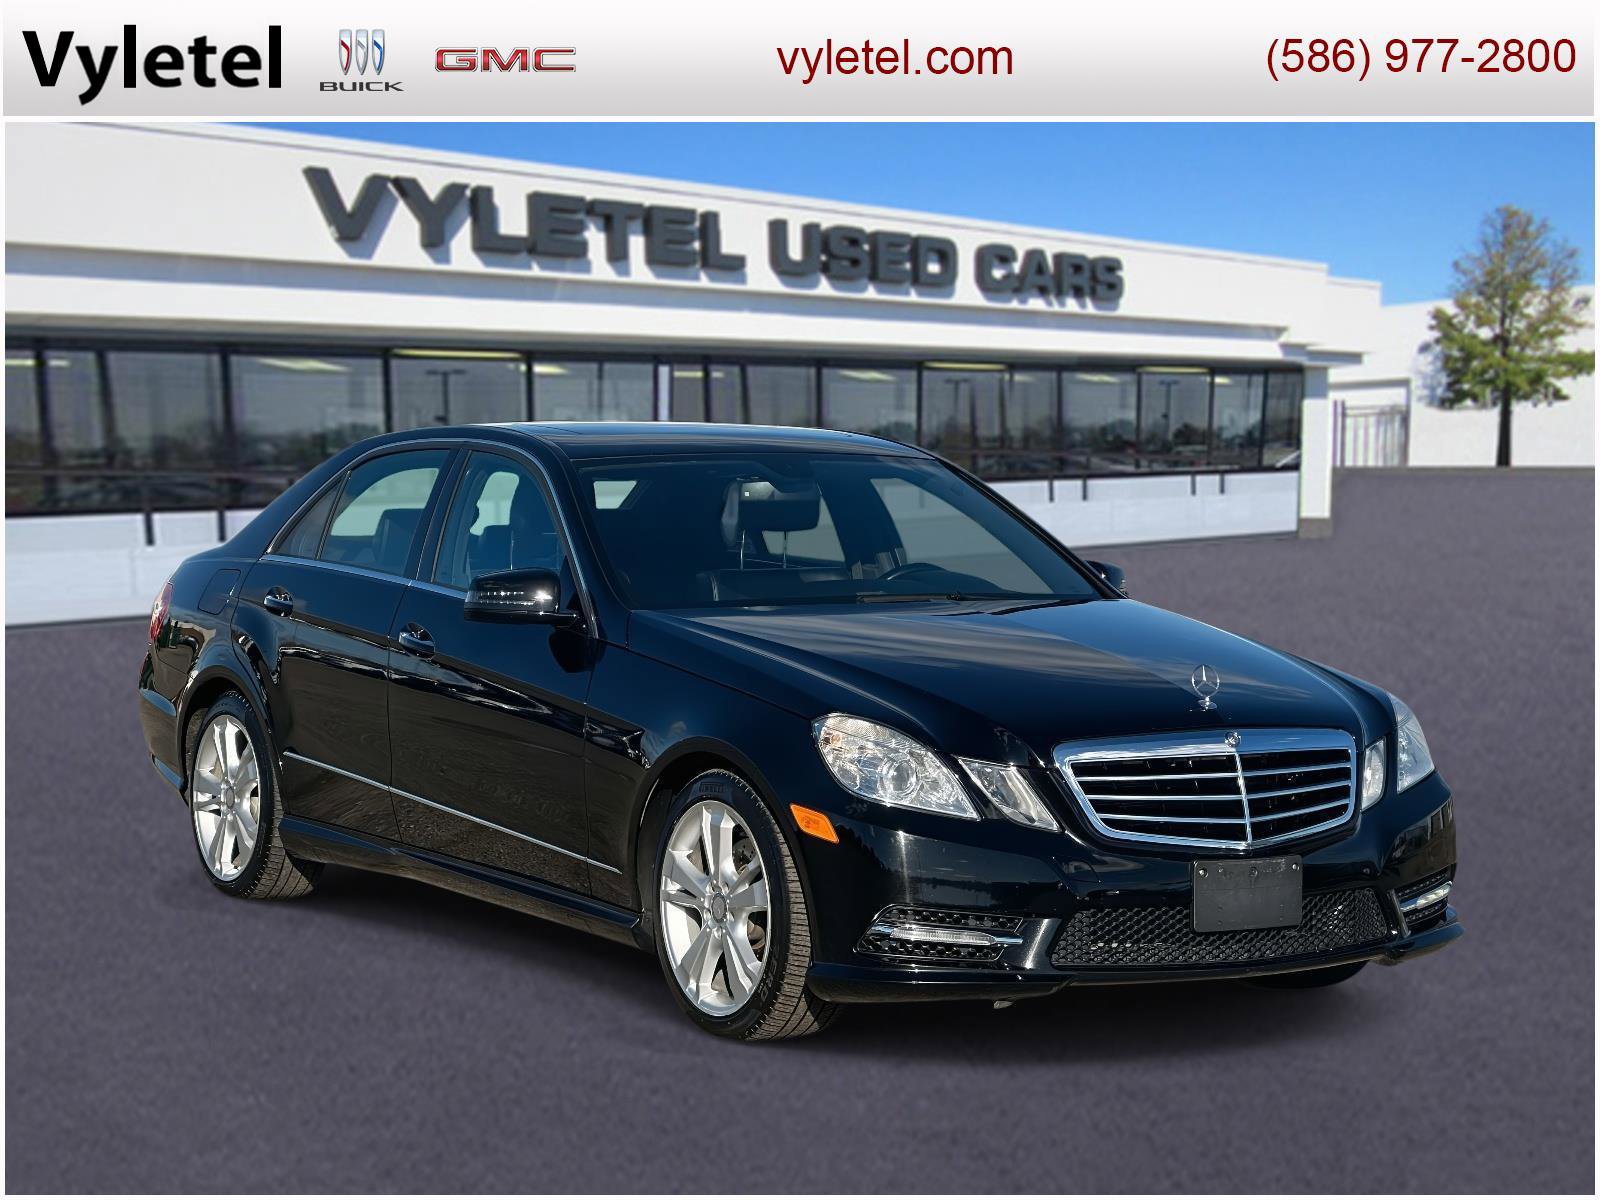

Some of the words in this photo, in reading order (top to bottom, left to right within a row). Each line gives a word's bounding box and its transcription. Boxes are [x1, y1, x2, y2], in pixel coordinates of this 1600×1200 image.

[302, 166, 747, 271] VYLETEL
[768, 218, 958, 288] USED
[974, 243, 1125, 304] CARS
